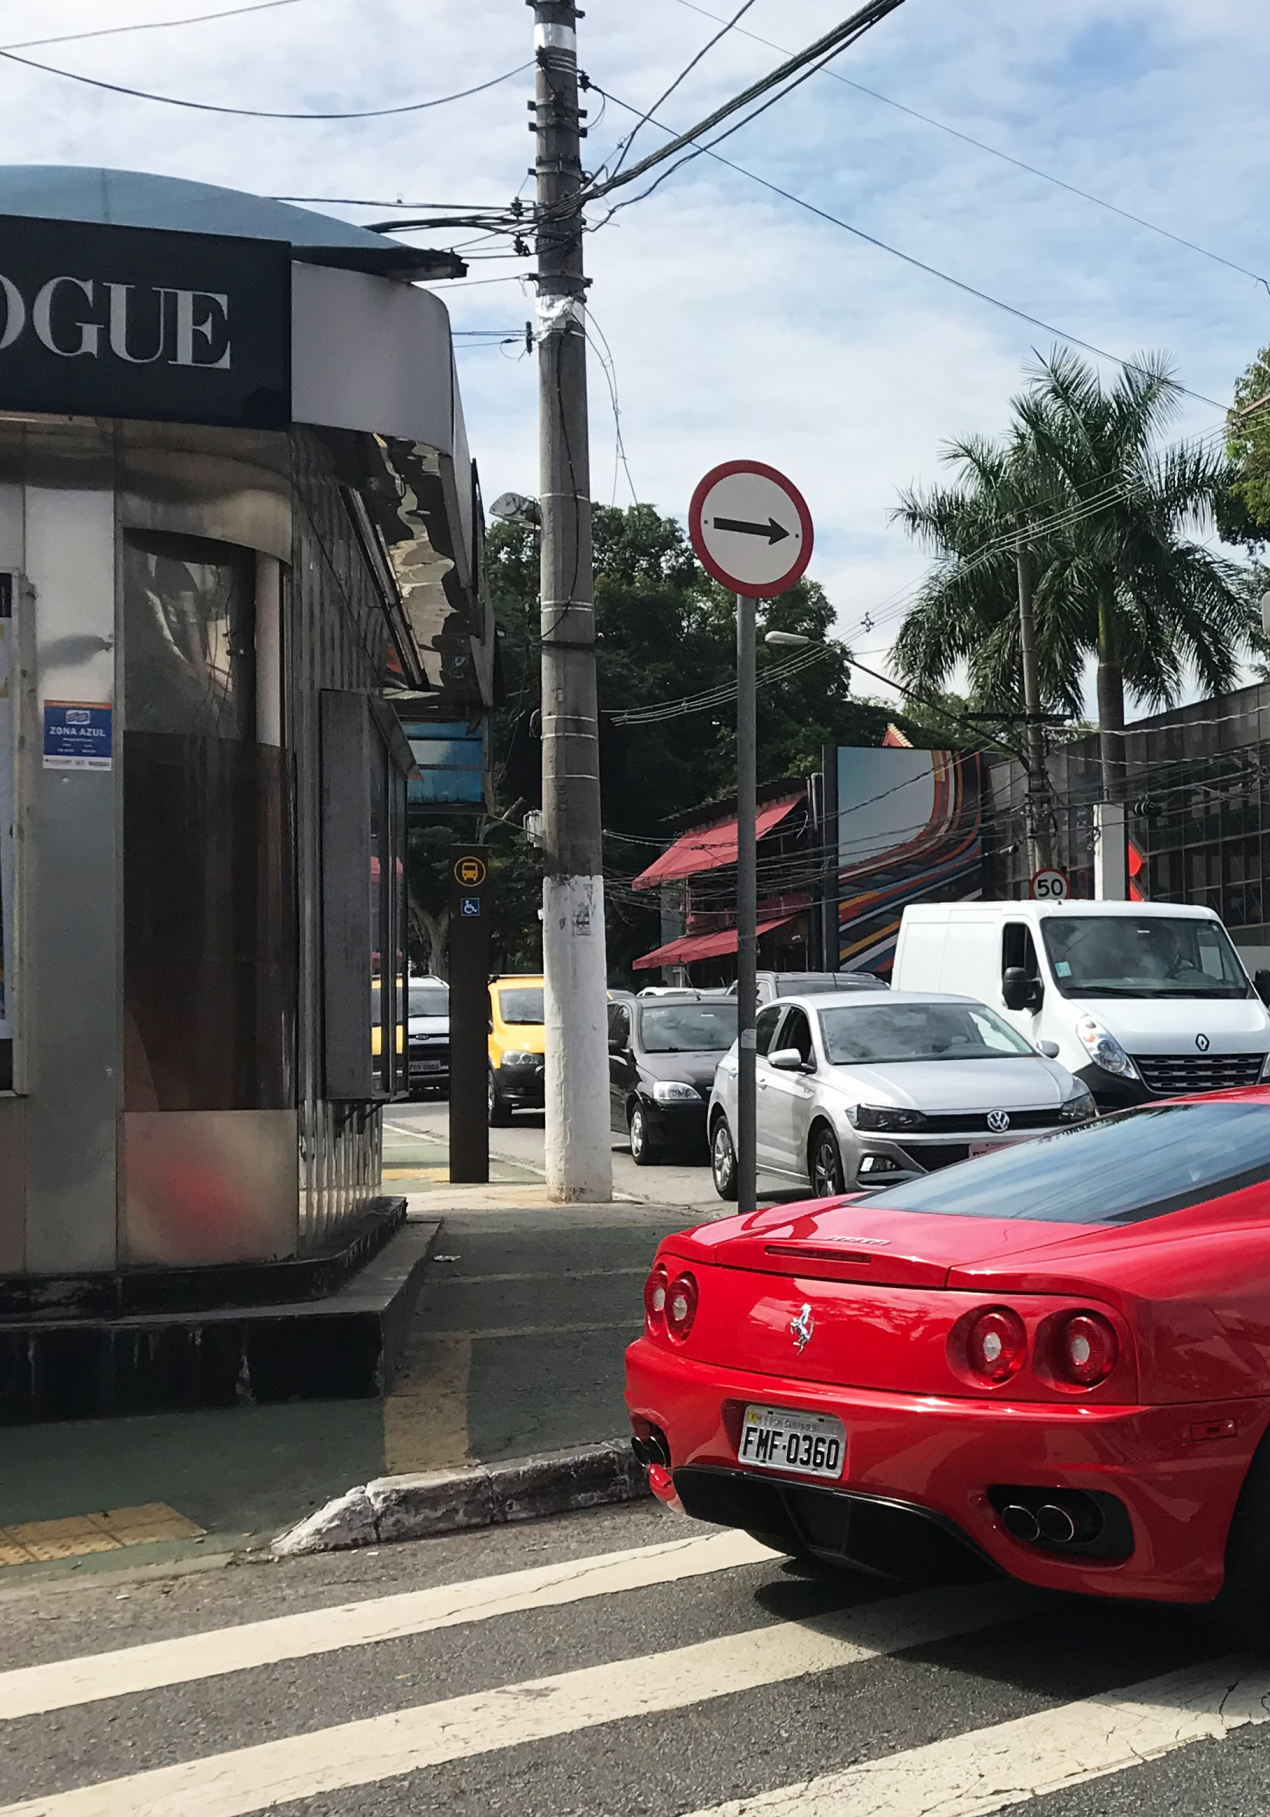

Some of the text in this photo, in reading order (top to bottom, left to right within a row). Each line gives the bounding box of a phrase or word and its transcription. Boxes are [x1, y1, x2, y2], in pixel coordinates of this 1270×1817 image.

[49, 726, 106, 737] ZONA AZUL
[1037, 879, 1063, 897] 50
